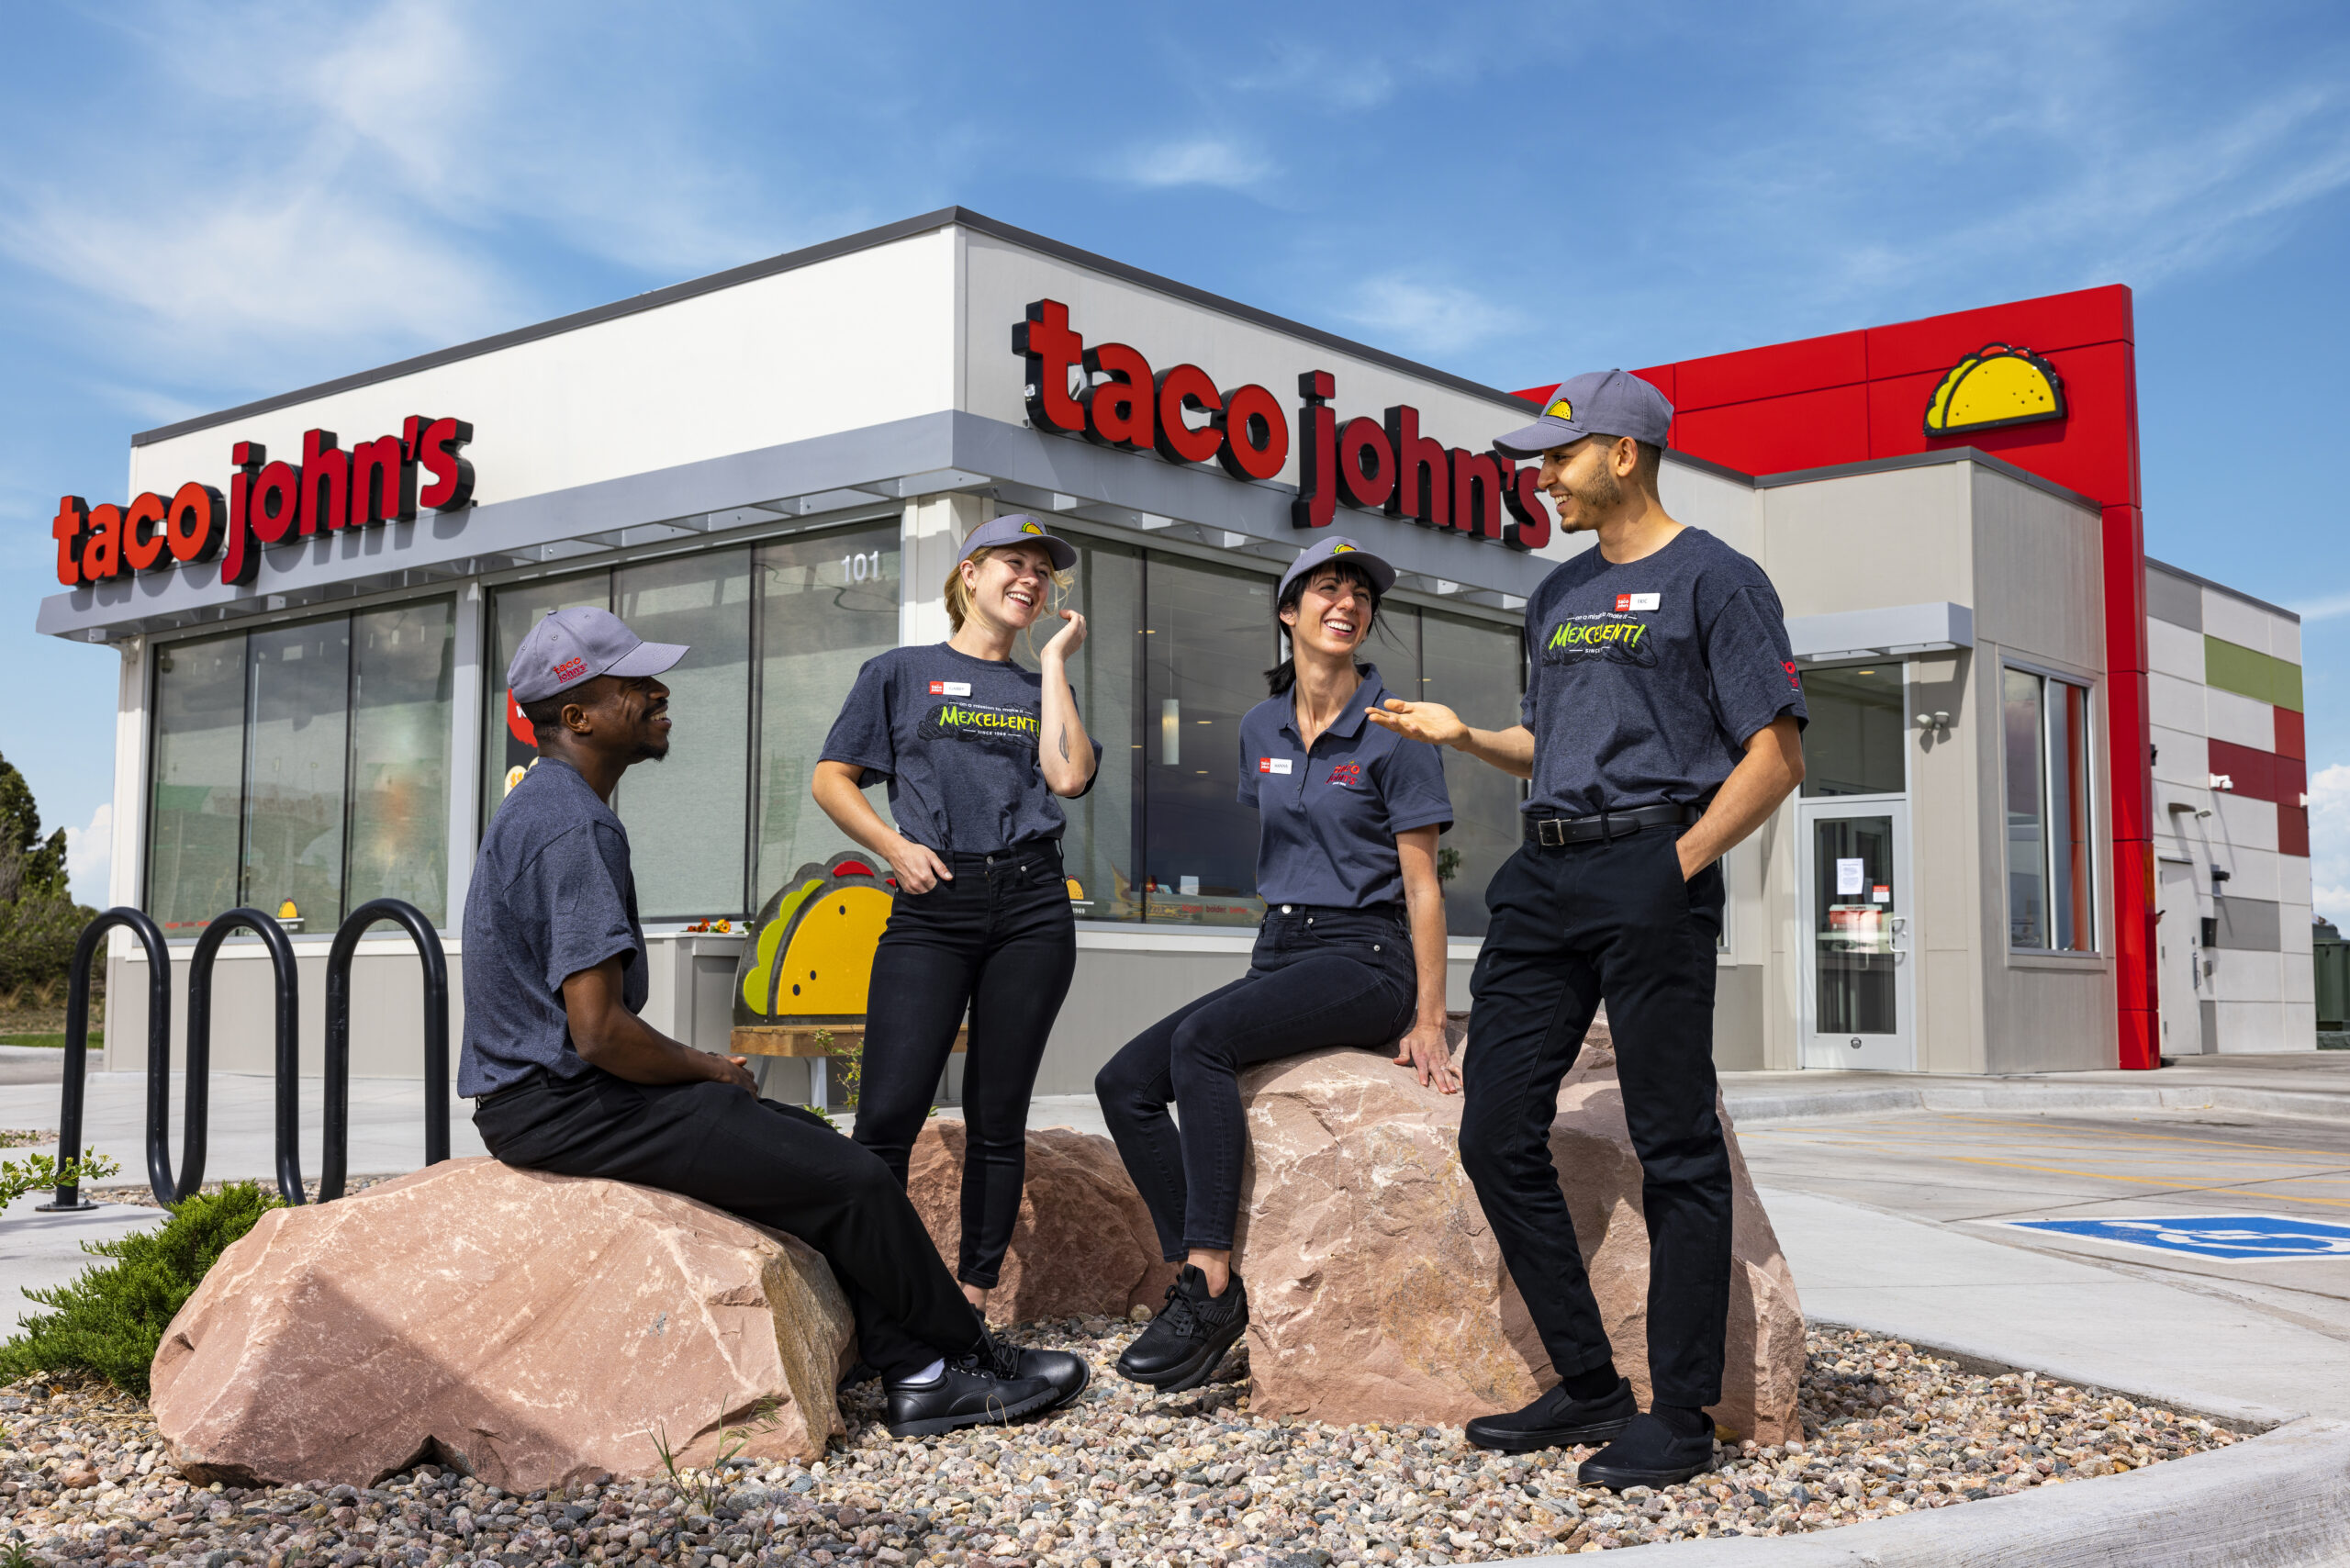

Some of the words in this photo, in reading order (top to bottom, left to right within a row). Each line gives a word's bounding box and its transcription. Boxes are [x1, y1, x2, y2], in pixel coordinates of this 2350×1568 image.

[1013, 298, 1290, 482] taco
[1292, 369, 1551, 551] john's
[52, 482, 226, 588] taco
[221, 415, 475, 586] john's
[840, 550, 879, 583] 101
[939, 705, 1040, 738] MEXCELLENT!
